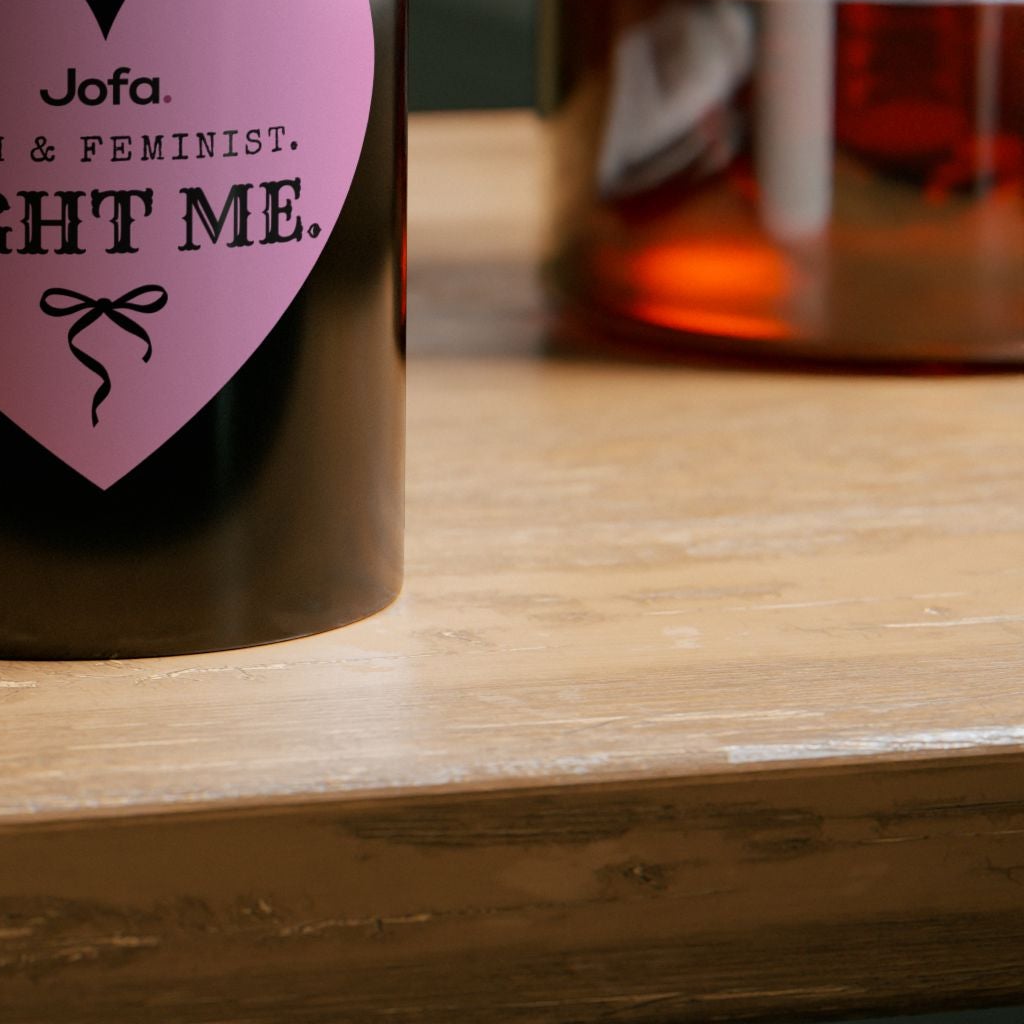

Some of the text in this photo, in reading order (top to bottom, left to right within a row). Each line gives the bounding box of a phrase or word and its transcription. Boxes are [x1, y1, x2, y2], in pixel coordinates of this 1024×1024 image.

[30, 135, 56, 163] &
[80, 126, 299, 163] FEMINIST.
[178, 177, 323, 252] ME.
